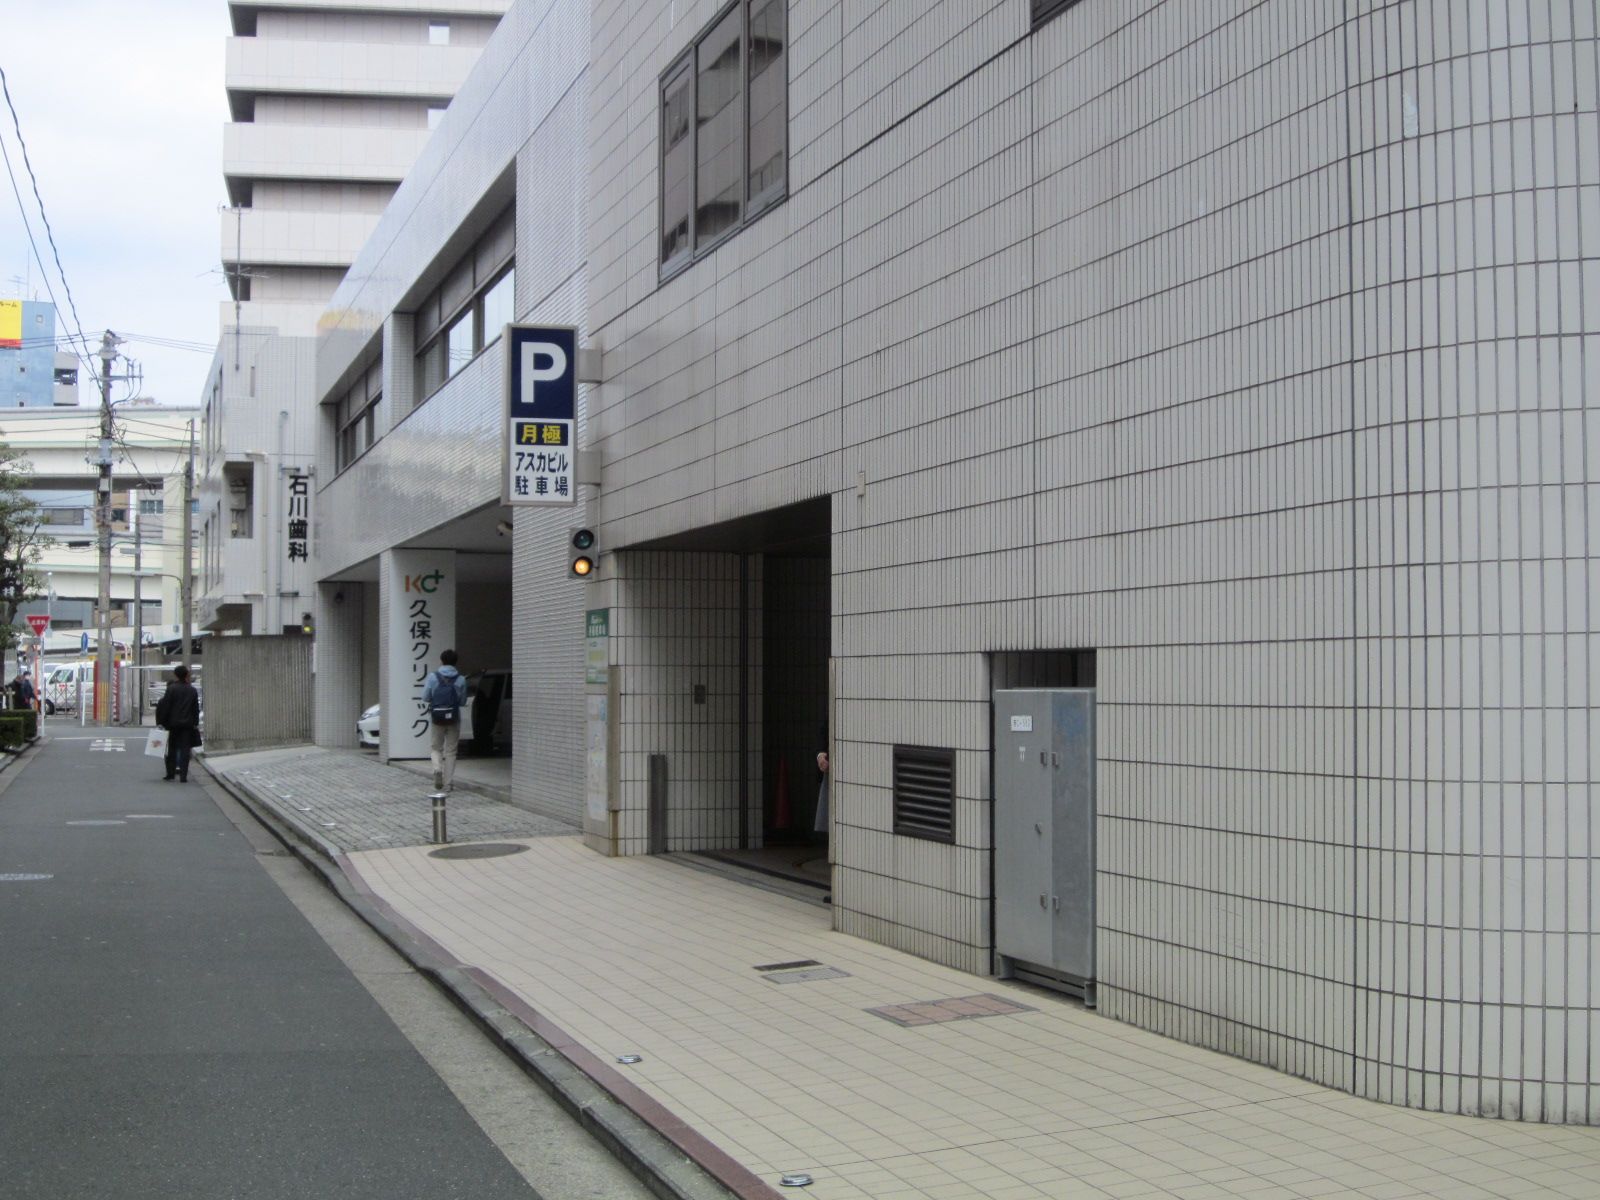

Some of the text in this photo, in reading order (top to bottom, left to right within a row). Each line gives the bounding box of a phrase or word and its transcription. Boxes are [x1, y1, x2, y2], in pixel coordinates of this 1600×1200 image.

[521, 342, 567, 403] P
[521, 424, 562, 444] 月極
[515, 451, 568, 473] アスカビル
[514, 475, 569, 496] 駐車場
[288, 475, 309, 563] 石川歯科
[409, 599, 432, 738] 久保クリニック
